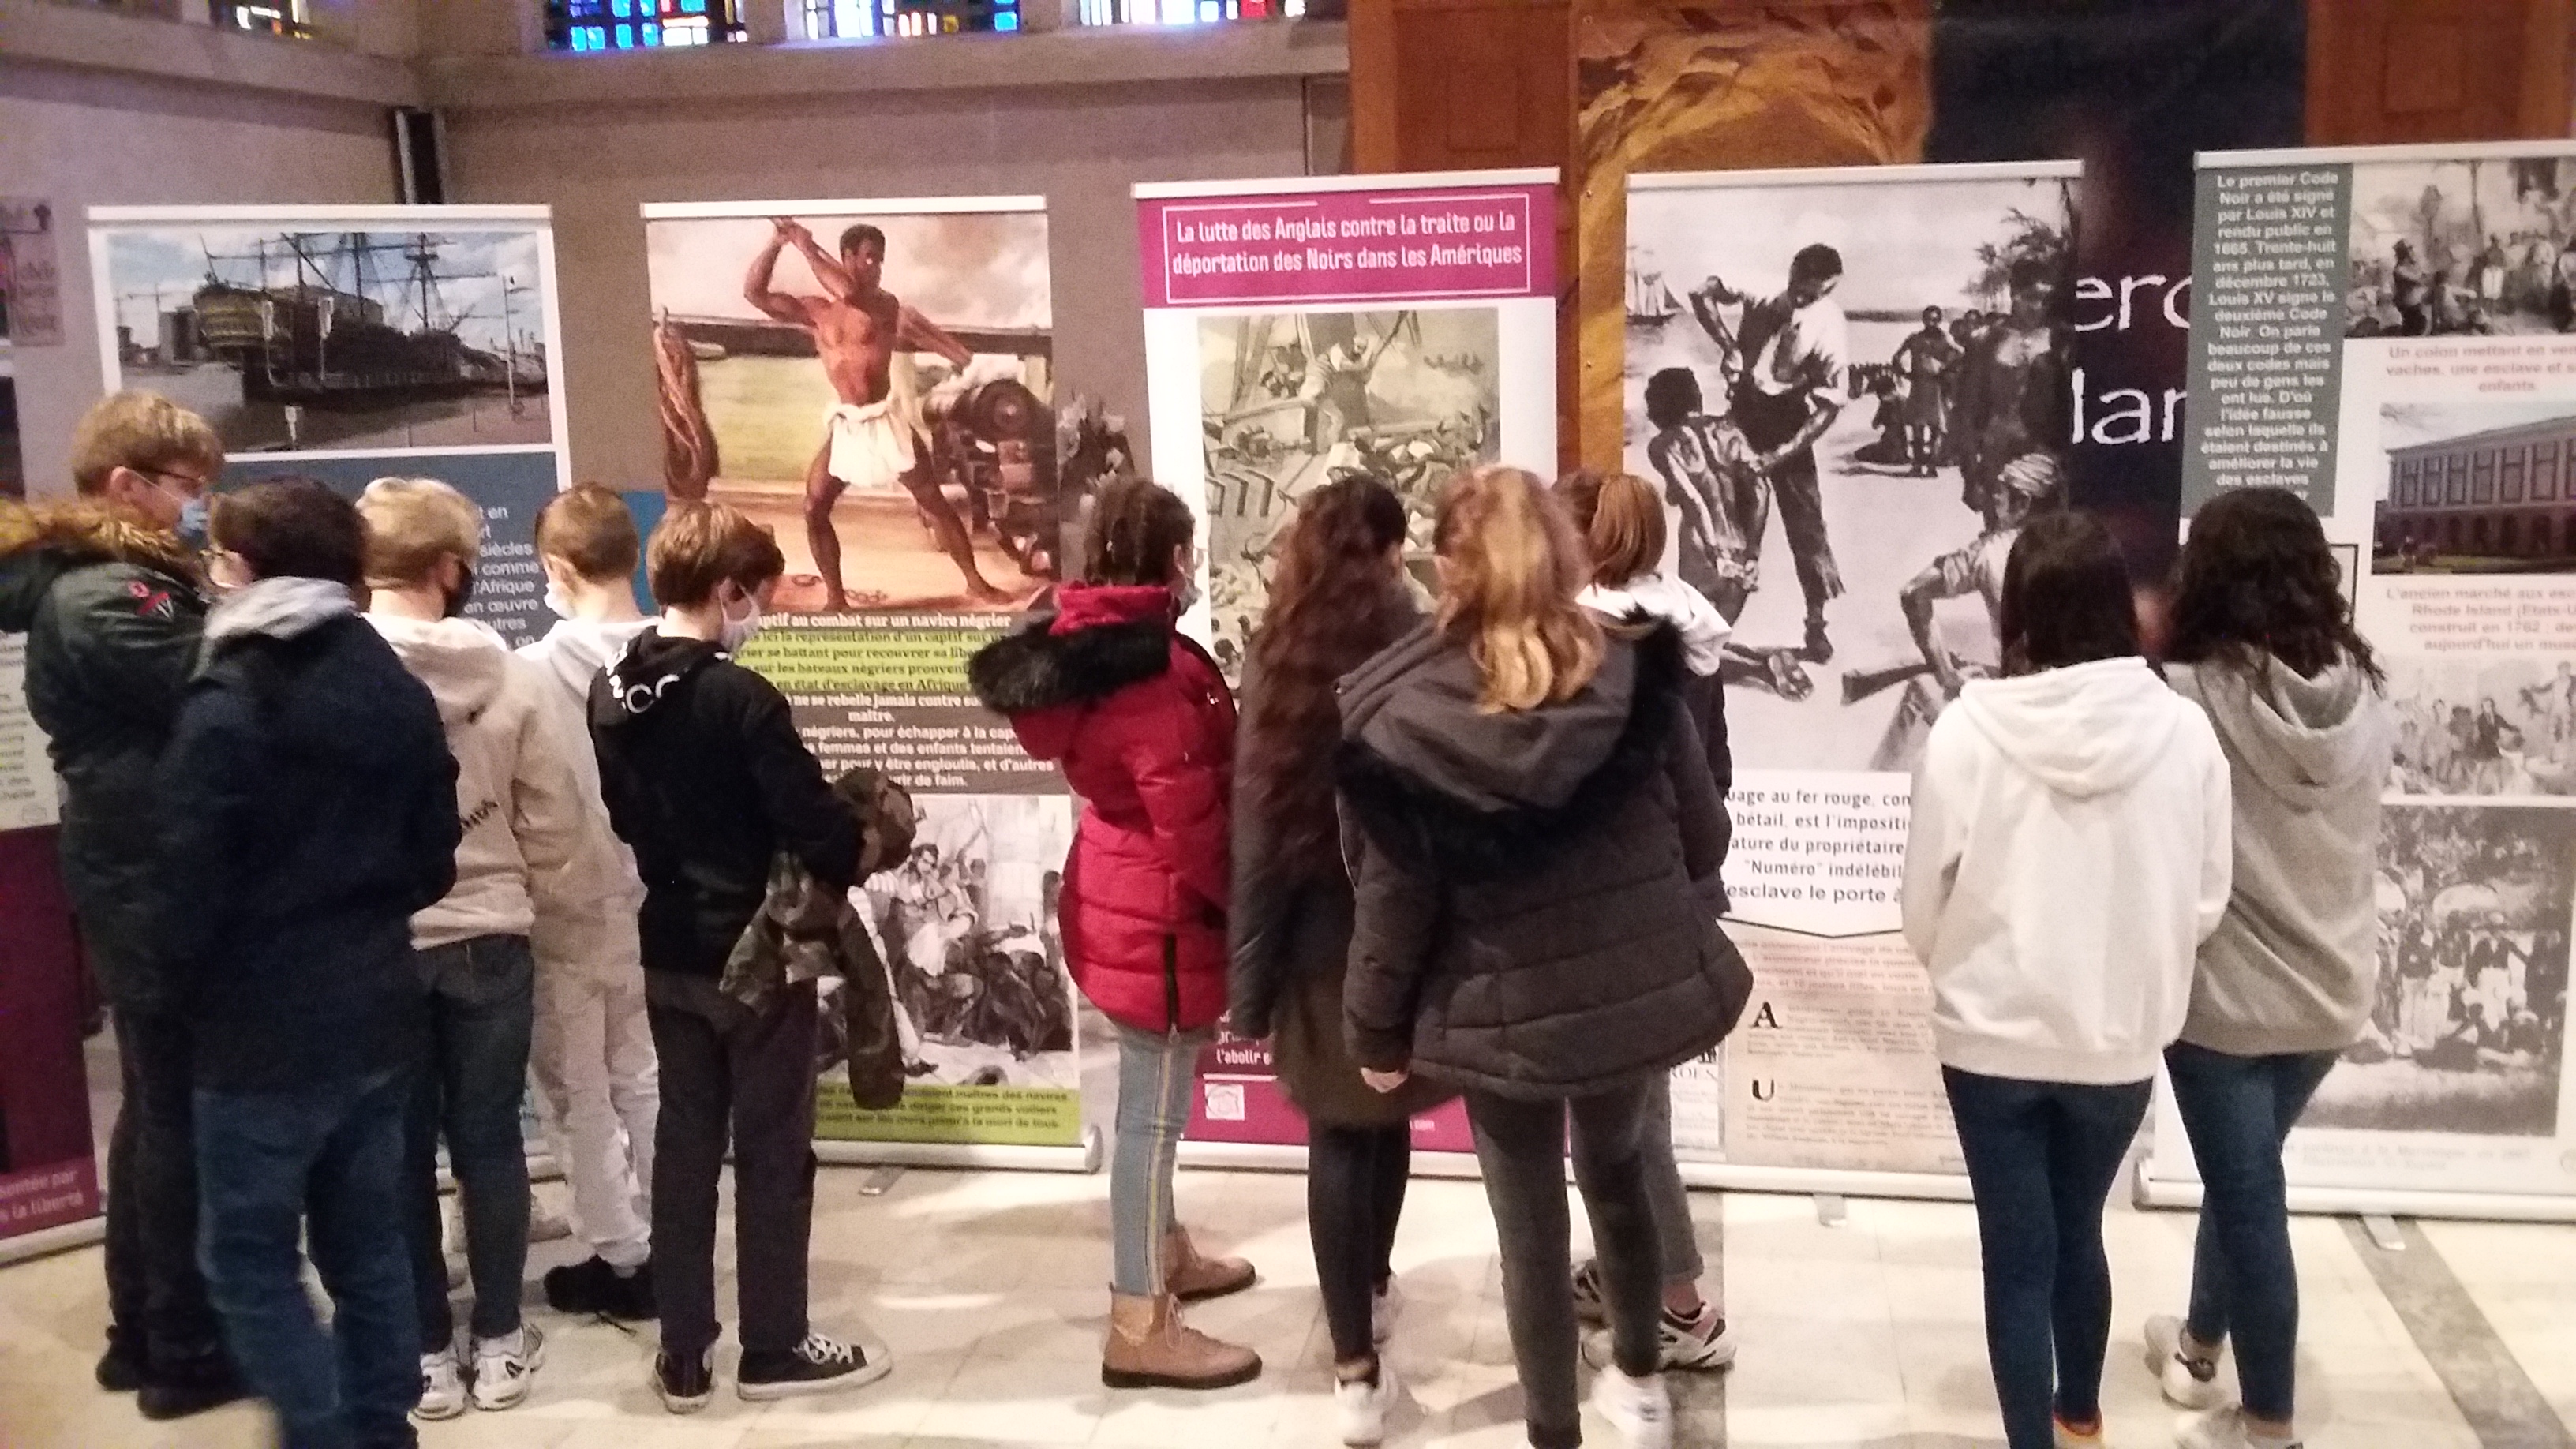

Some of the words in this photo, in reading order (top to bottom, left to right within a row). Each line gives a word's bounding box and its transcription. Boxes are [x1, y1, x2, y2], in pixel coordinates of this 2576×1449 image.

[2217, 175, 2235, 188] Le
[2240, 174, 2295, 189] premier
[2300, 171, 2338, 185] Code
[2220, 192, 2249, 204] Noir
[2254, 194, 2263, 204] a
[2293, 189, 2334, 204] signé
[2218, 210, 2242, 224] par
[2246, 208, 2287, 220] Louis
[2292, 207, 2316, 219] XIV
[2320, 207, 2334, 218] et
[1177, 220, 1194, 242] La
[1199, 221, 1237, 242] lutte
[1242, 219, 1271, 240] des
[1275, 216, 1336, 242] Anglais
[1341, 216, 1395, 237] contre
[1401, 214, 1416, 235] la
[1421, 212, 1470, 234] traite
[1474, 215, 1494, 232] ou
[1500, 210, 1515, 231] la
[2218, 225, 2261, 238] rendu
[2265, 223, 2310, 238] public
[2313, 225, 2332, 235] en
[2255, 239, 2336, 254] Trente-huit
[1173, 251, 1269, 277] déportation
[1273, 249, 1302, 271] des
[1307, 248, 1353, 270] Noirs
[1357, 247, 1397, 268] dans
[1402, 245, 1426, 267] les
[1431, 242, 1522, 268] Amériques
[2213, 262, 2239, 272] ans
[2243, 259, 2275, 273] plus
[2316, 259, 2334, 270] en
[2215, 275, 2287, 289] décembre
[2208, 293, 2249, 305] Louis
[2253, 291, 2274, 305] XV
[2278, 292, 2318, 306] signe
[2322, 290, 2336, 303] le
[2215, 309, 2285, 322] deuxième
[2289, 308, 2327, 320] Code
[2259, 325, 2279, 338] On
[2284, 325, 2321, 339] parle
[2207, 343, 2279, 356] beaucoup
[2283, 342, 2301, 354] de
[2305, 343, 2331, 353] ces
[2207, 359, 2242, 372] deux
[2247, 358, 2290, 371] codes
[2294, 358, 2330, 370] mais
[2484, 363, 2541, 374] esclave
[2211, 377, 2237, 390] peu
[2241, 375, 2260, 388] de
[2263, 376, 2299, 389] gens
[2303, 374, 2324, 386] les
[2221, 392, 2245, 404] ont
[2263, 406, 2311, 420] fausse
[2204, 425, 2244, 437] selon
[2248, 423, 2305, 438] laquelle
[2308, 424, 2326, 435] ils
[2200, 440, 2250, 454] étaient
[2253, 440, 2315, 453] destinés
[2319, 439, 2328, 451] à
[2209, 456, 2276, 470] améliorer
[2280, 455, 2293, 468] la
[2297, 455, 2318, 468] vie
[2216, 473, 2242, 485] des
[2246, 472, 2309, 485] esclaves
[487, 506, 508, 519] en
[479, 542, 534, 557] siècles
[481, 560, 539, 576] comme
[464, 602, 484, 614] en
[791, 616, 808, 627] au
[811, 612, 863, 627] combat
[864, 616, 888, 627] sur
[890, 616, 909, 627] un
[912, 612, 957, 627] navire
[960, 612, 1011, 630] négrier
[833, 648, 862, 660] pour
[867, 648, 930, 657] recouvrer
[798, 663, 848, 672] bateaux
[852, 663, 908, 675] négriers
[792, 695, 809, 706] ne
[811, 695, 825, 706] se
[827, 693, 871, 706] rebelle
[873, 693, 916, 709] jamais
[918, 695, 960, 706] contre
[863, 727, 894, 740] pour
[897, 724, 959, 741] échapper
[962, 725, 972, 738] à
[974, 725, 986, 738] la
[818, 741, 871, 754] femmes
[874, 742, 887, 754] et
[889, 742, 914, 754] des
[917, 742, 968, 754] enfants
[886, 757, 912, 770] être
[983, 758, 997, 771] et
[1000, 758, 1054, 771] d'autres
[915, 774, 932, 786] de
[1771, 792, 1790, 803] au
[1796, 789, 1818, 803] fer
[1795, 816, 1819, 828] est
[1780, 837, 1799, 852] du
[1810, 885, 1825, 900] le
[1833, 887, 1885, 904] porte
[1749, 1002, 1783, 1029] A
[1216, 1048, 1261, 1065] l'abolir
[1752, 1079, 1775, 1102] U
